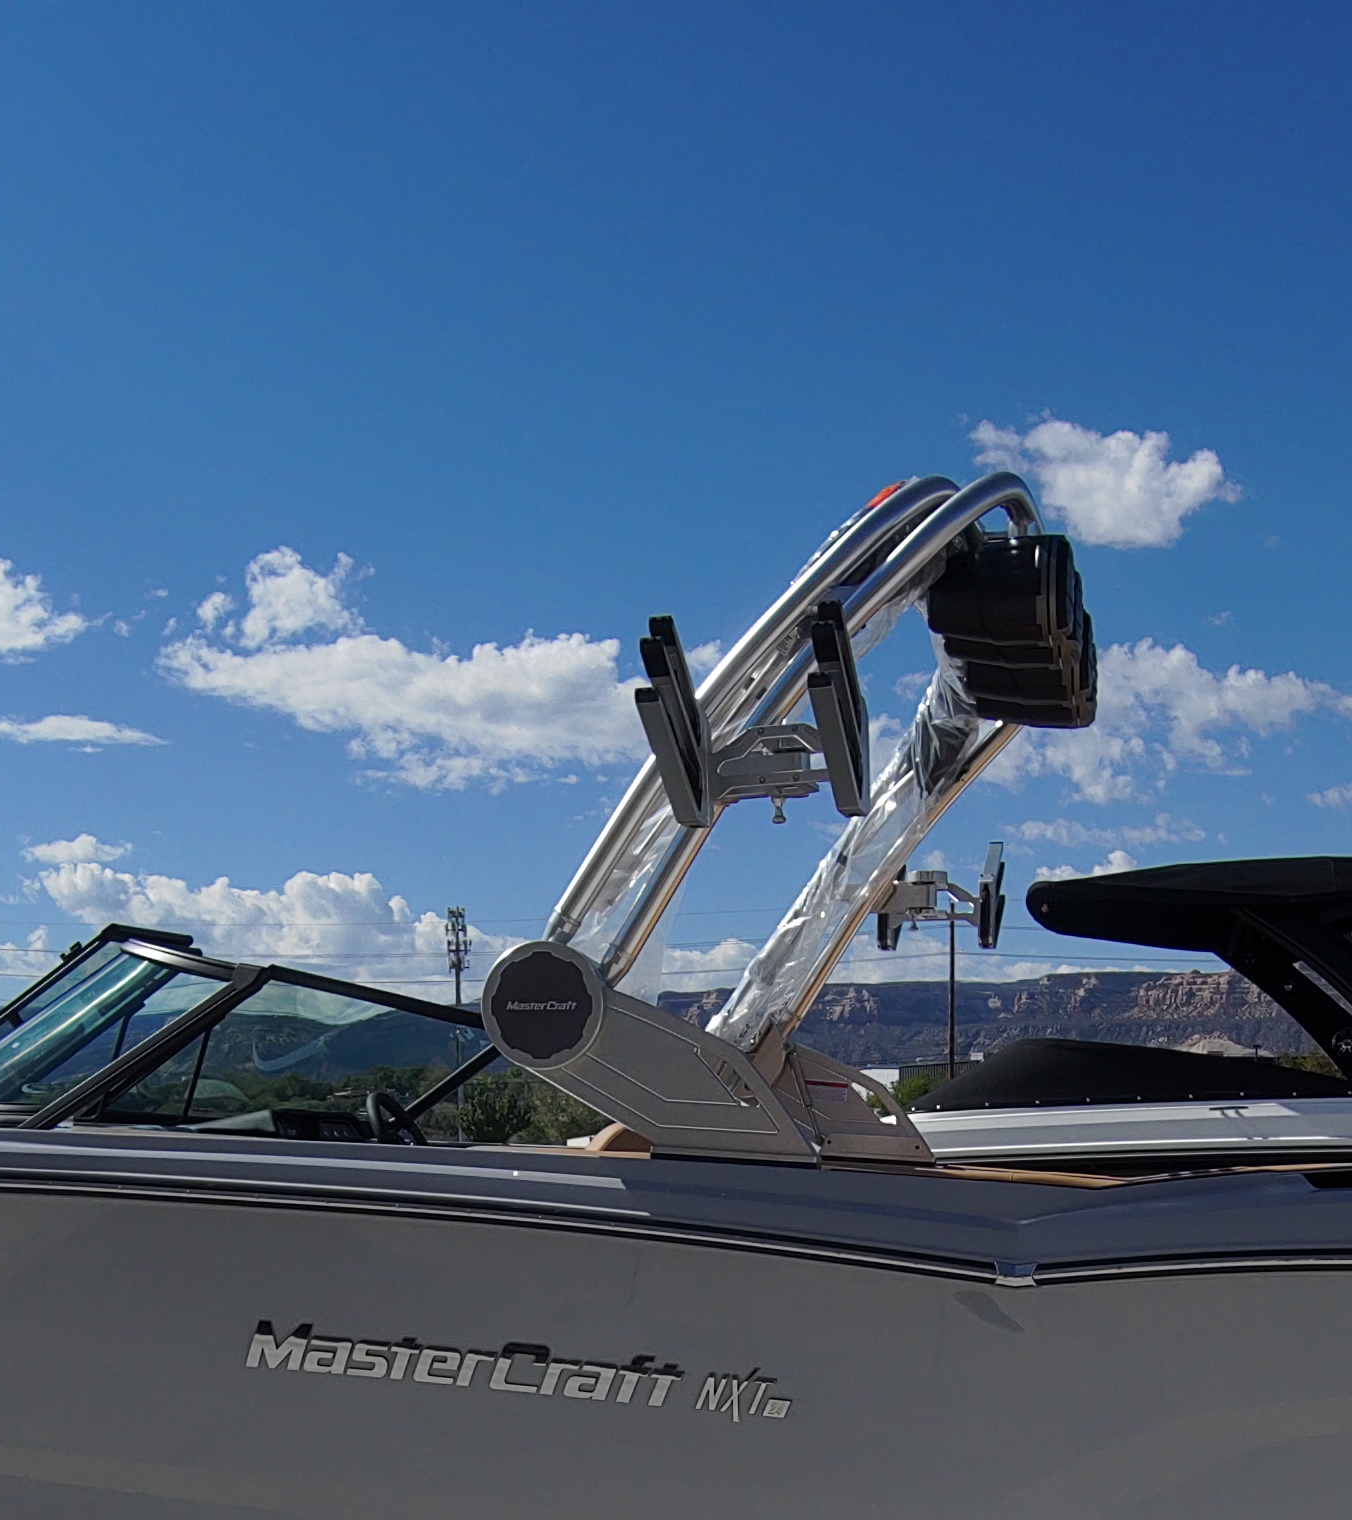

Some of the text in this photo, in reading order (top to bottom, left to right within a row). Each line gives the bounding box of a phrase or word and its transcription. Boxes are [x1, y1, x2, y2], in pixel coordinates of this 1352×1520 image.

[506, 1000, 577, 1011] MasterCraft
[245, 1319, 685, 1407] MasterCraft
[695, 1367, 778, 1422] NXT
